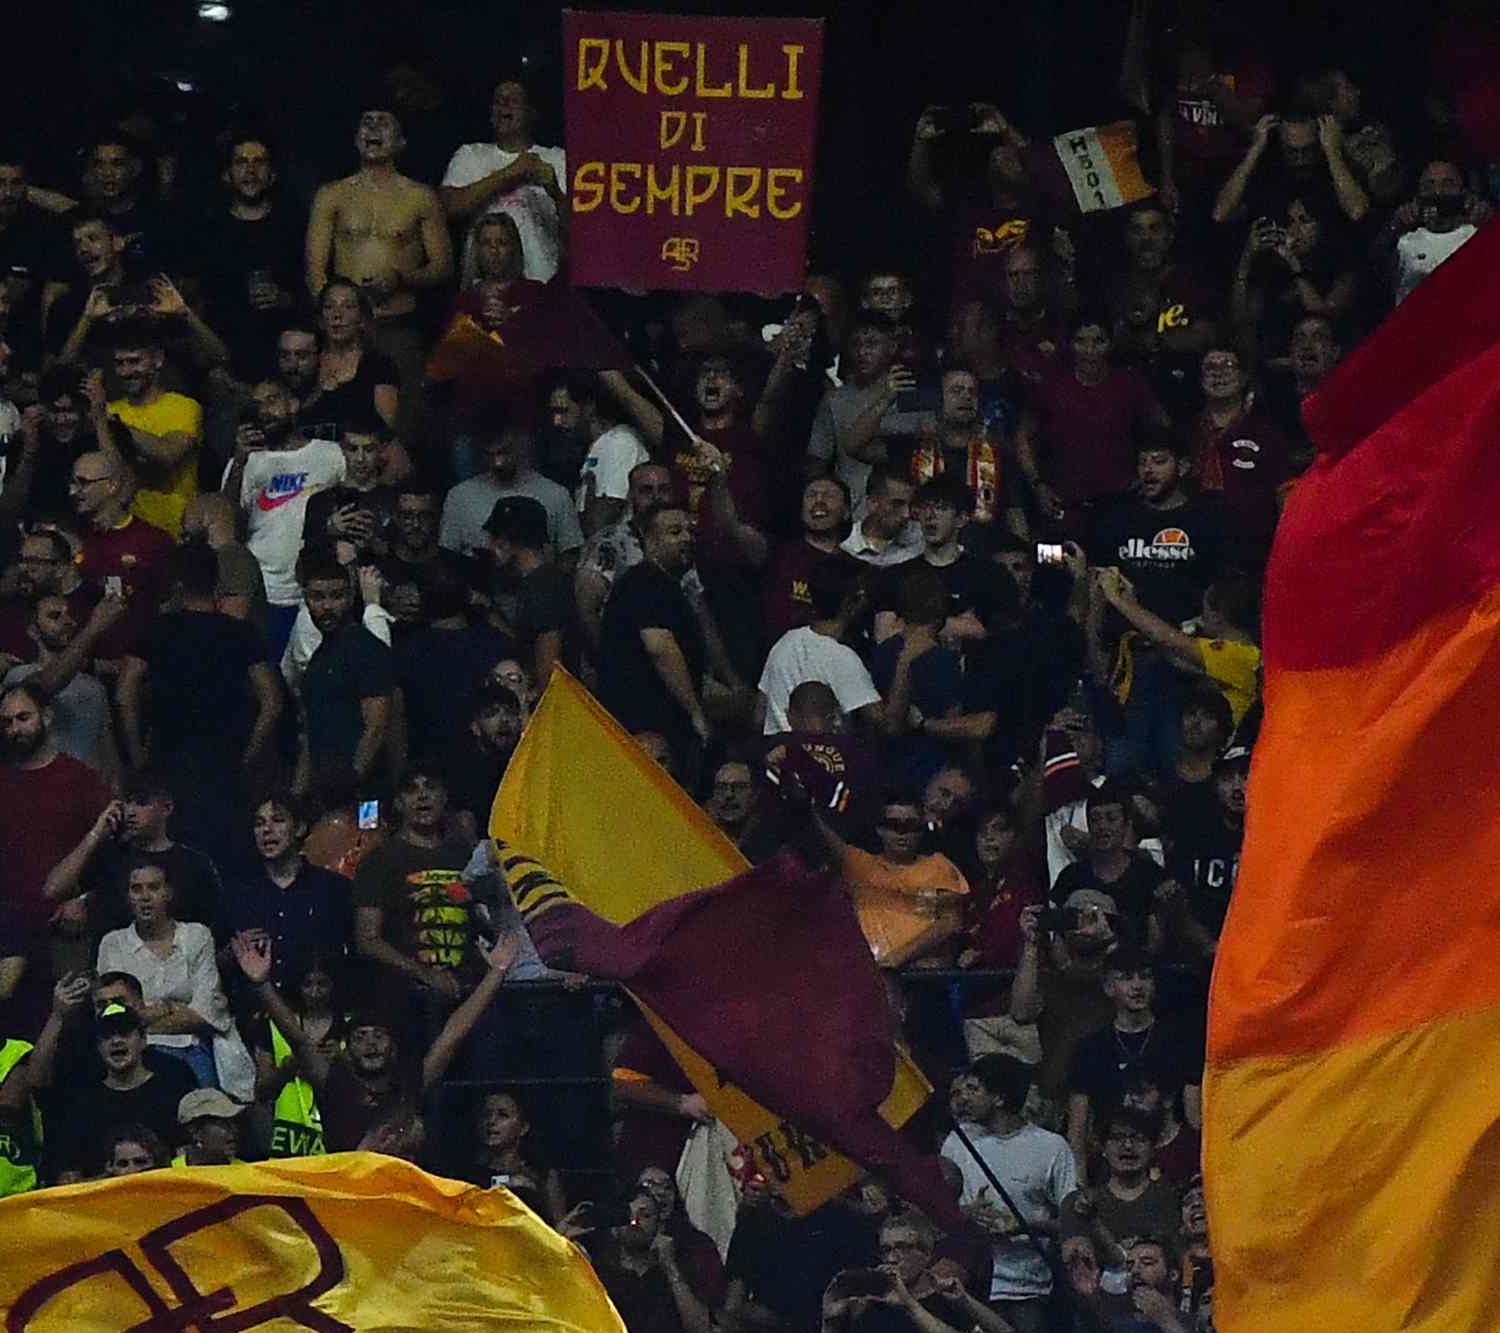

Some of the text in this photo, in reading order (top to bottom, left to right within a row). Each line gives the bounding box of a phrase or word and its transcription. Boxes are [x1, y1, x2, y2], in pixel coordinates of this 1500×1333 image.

[659, 111, 705, 151] DI
[571, 164, 804, 218] SEMPRE
[270, 473, 309, 493] NIKE
[1118, 538, 1196, 561] ellesse
